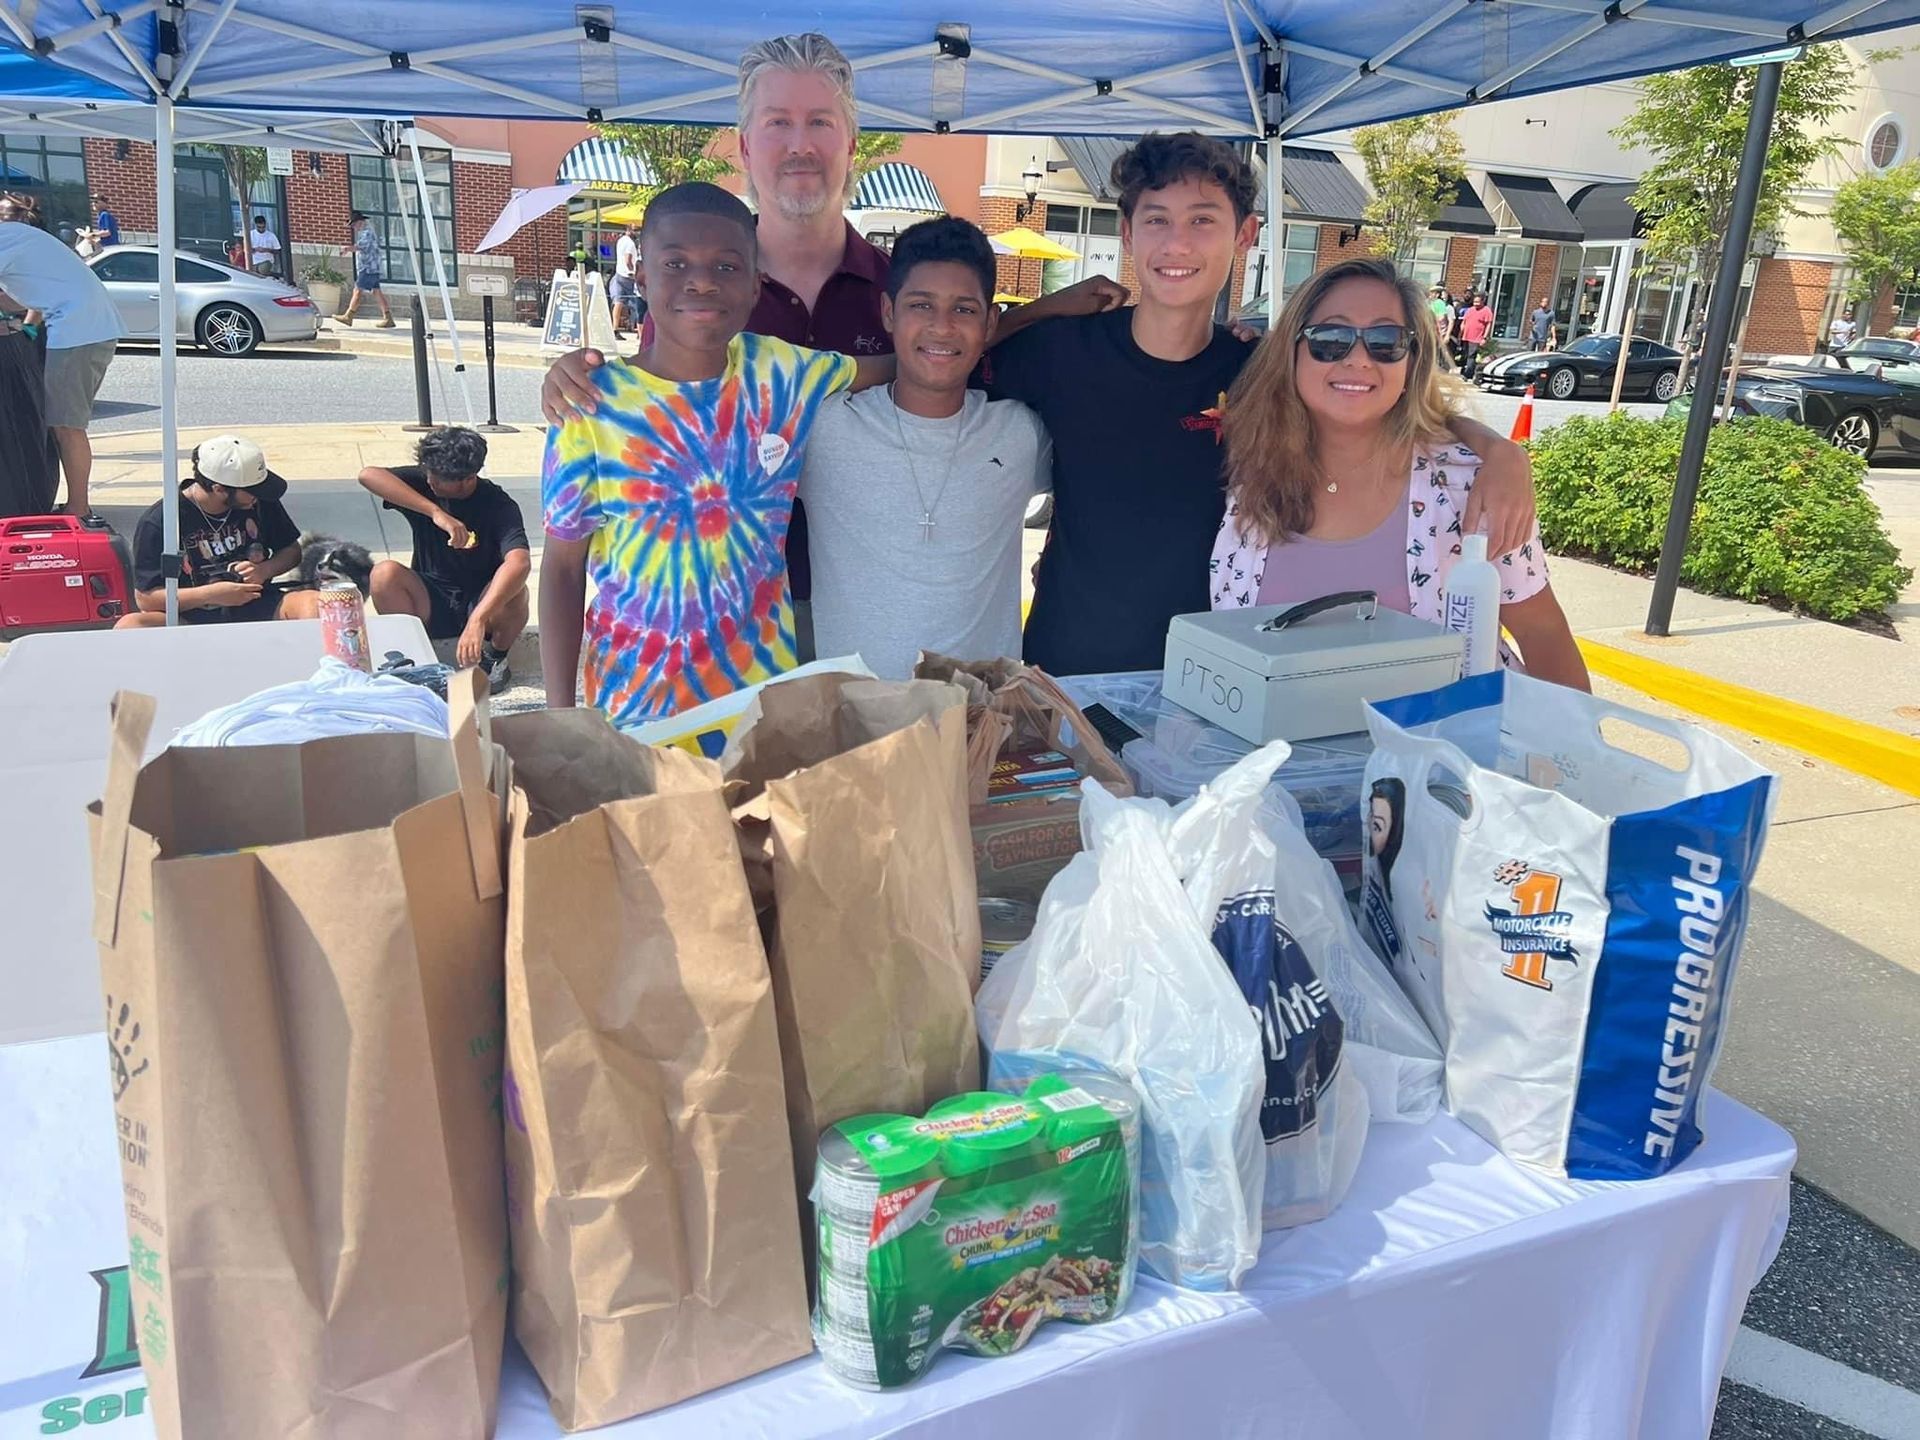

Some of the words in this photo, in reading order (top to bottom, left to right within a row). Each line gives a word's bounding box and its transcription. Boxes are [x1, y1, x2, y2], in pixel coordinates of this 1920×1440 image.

[1181, 657, 1244, 714] PTSO
[1492, 914, 1571, 933] MOTORCYCLE
[1502, 937, 1568, 952] INSURANCE
[1643, 844, 1724, 1159] PROGRESSIVE
[135, 1119, 149, 1146] IN
[944, 1218, 1007, 1247] Chicken
[1031, 1203, 1058, 1221] Sea
[959, 1241, 994, 1260] CHUNK
[1024, 1223, 1054, 1241] LIGHT
